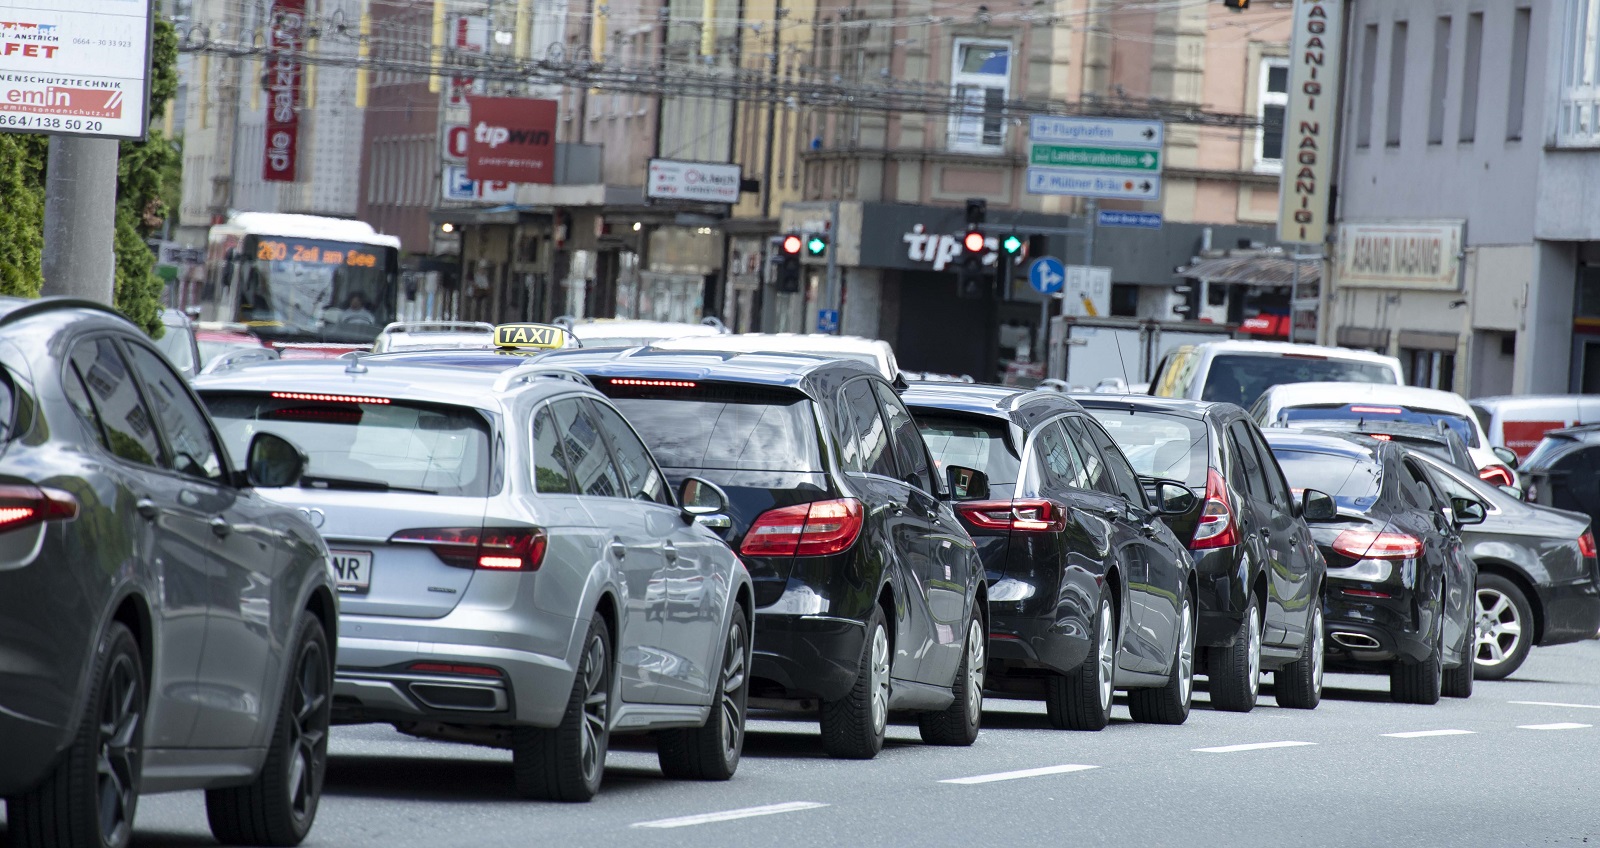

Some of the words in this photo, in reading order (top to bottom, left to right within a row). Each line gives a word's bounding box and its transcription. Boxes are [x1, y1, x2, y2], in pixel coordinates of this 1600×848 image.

[0, 42, 59, 59] FET
[1303, 5, 1327, 111] AGANIGI
[7, 87, 71, 107] emin
[65, 119, 82, 130] 50
[86, 120, 103, 132] 20
[475, 121, 549, 148] tipwin
[1053, 124, 1113, 138] Flughafen
[270, 131, 291, 171] die
[1051, 149, 1138, 167] Landeskrankenhaus
[1295, 121, 1319, 239] NAGANIGI
[293, 244, 319, 262] Zell
[346, 249, 376, 267] See
[502, 327, 552, 344] TAXI
